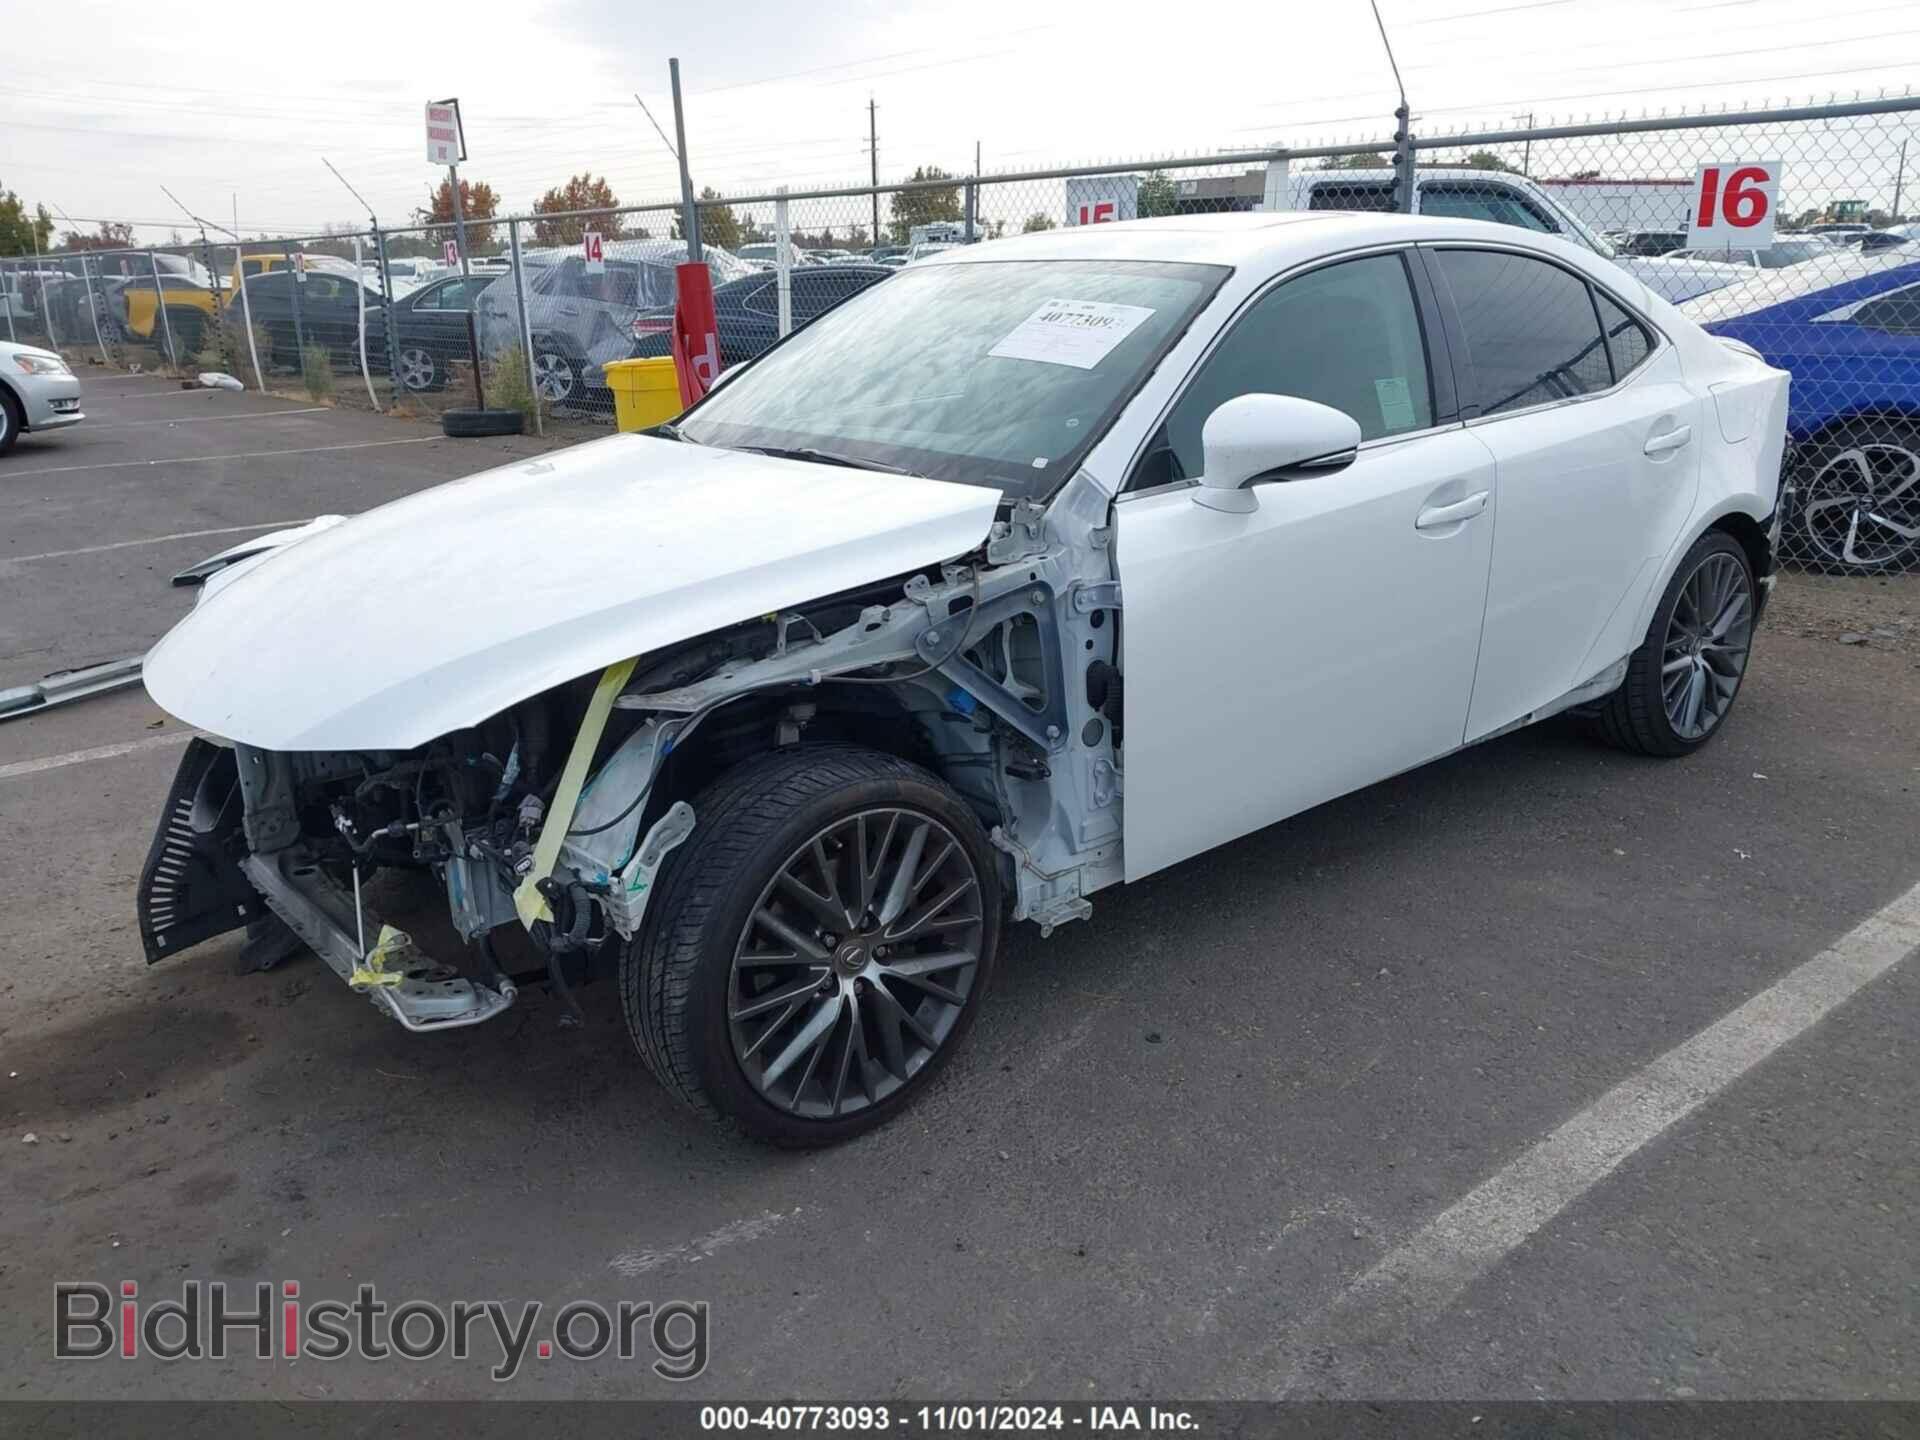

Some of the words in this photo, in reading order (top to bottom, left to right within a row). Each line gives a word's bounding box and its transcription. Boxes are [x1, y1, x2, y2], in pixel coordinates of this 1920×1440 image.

[1697, 167, 1770, 228] 16
[445, 242, 457, 267] 13
[585, 235, 603, 263] 14
